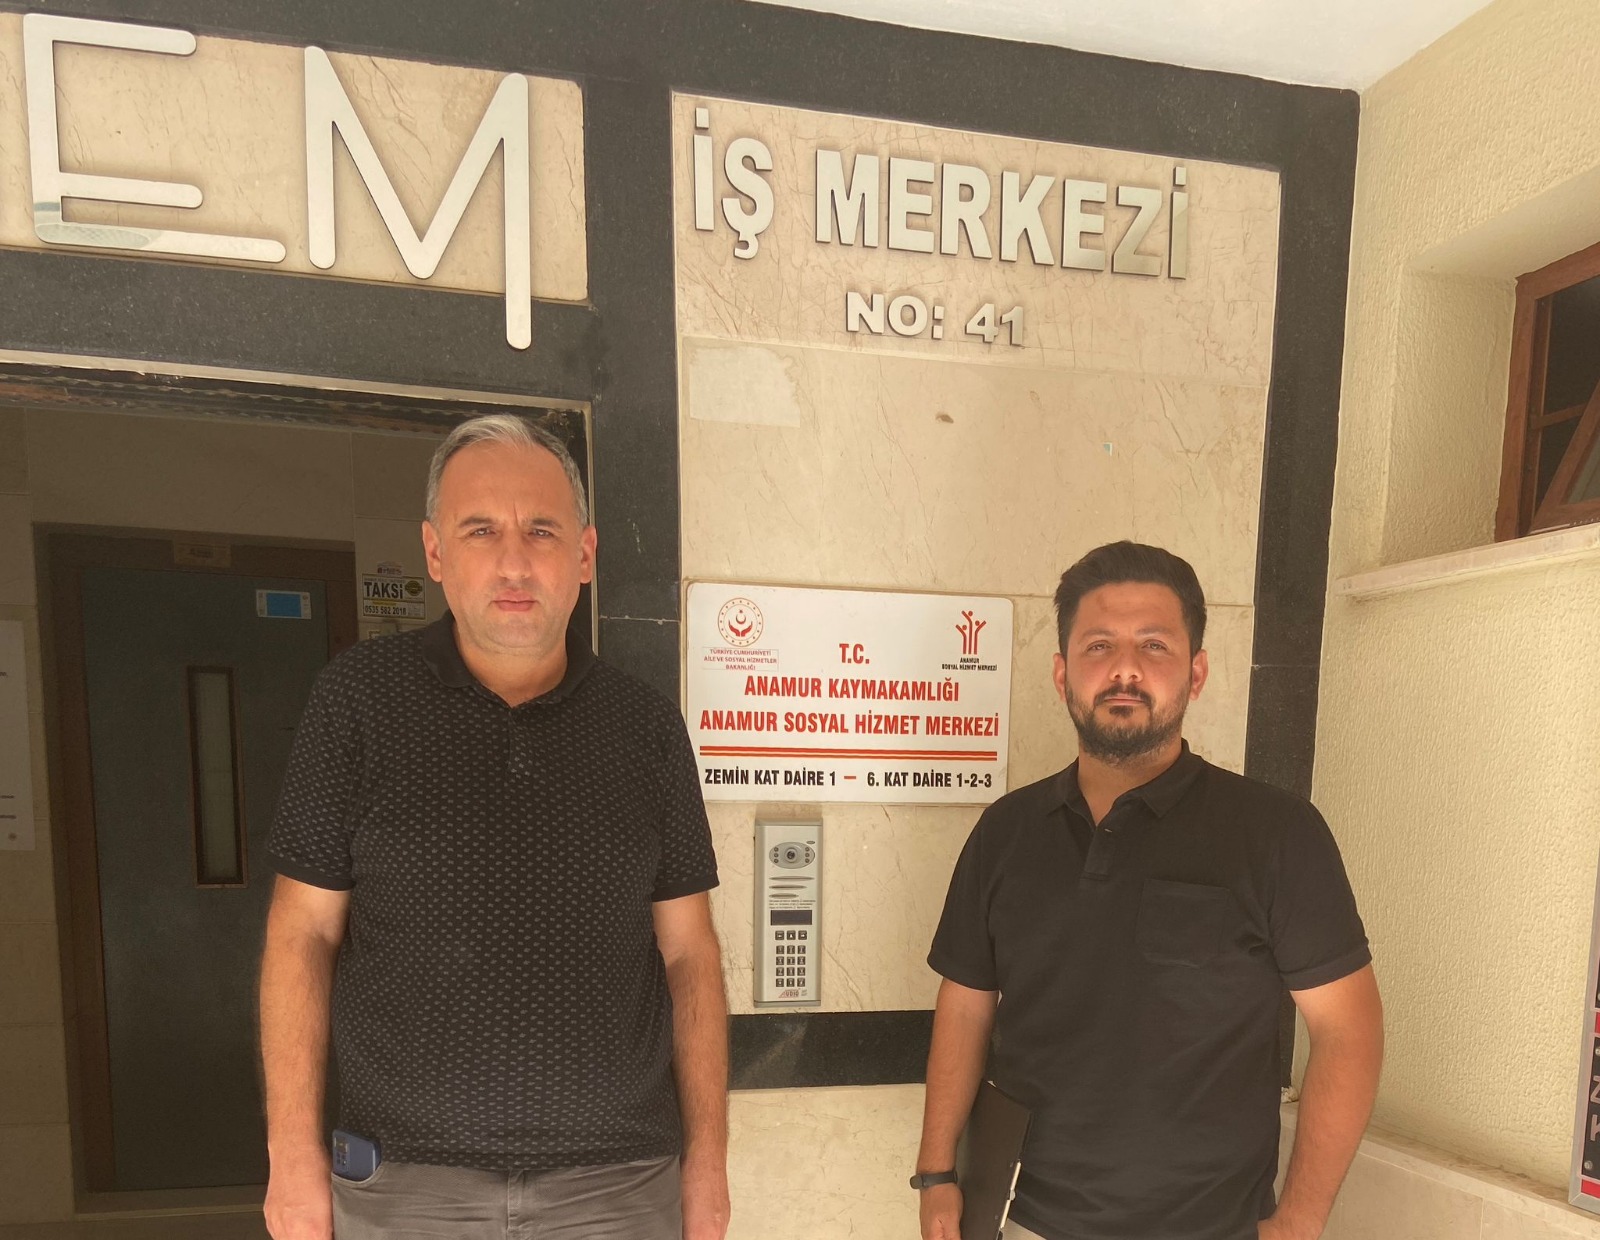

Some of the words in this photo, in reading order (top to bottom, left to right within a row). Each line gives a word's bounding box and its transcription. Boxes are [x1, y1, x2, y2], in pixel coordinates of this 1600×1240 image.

[692, 107, 774, 260] İŞ
[815, 149, 1189, 280] MERKEZİ
[845, 291, 945, 340] NO:
[965, 303, 1024, 345] 41
[839, 643, 870, 665] T.C.
[744, 675, 822, 698] ANAMUR
[828, 677, 959, 702] KAYMAKAMLIĞI
[700, 710, 778, 732] ANAMUR
[784, 712, 848, 734] SOSYAL
[855, 709, 920, 735] HİZMET
[926, 712, 999, 736] MERKEZİ
[704, 766, 749, 785] ZEMİN
[754, 769, 780, 785] KAT
[784, 767, 825, 786] DAİRE
[829, 771, 836, 786] 1
[867, 772, 880, 787] 6.
[884, 772, 909, 787] KAT
[912, 769, 952, 787] DAİRE
[957, 773, 992, 788] 1-2-3
